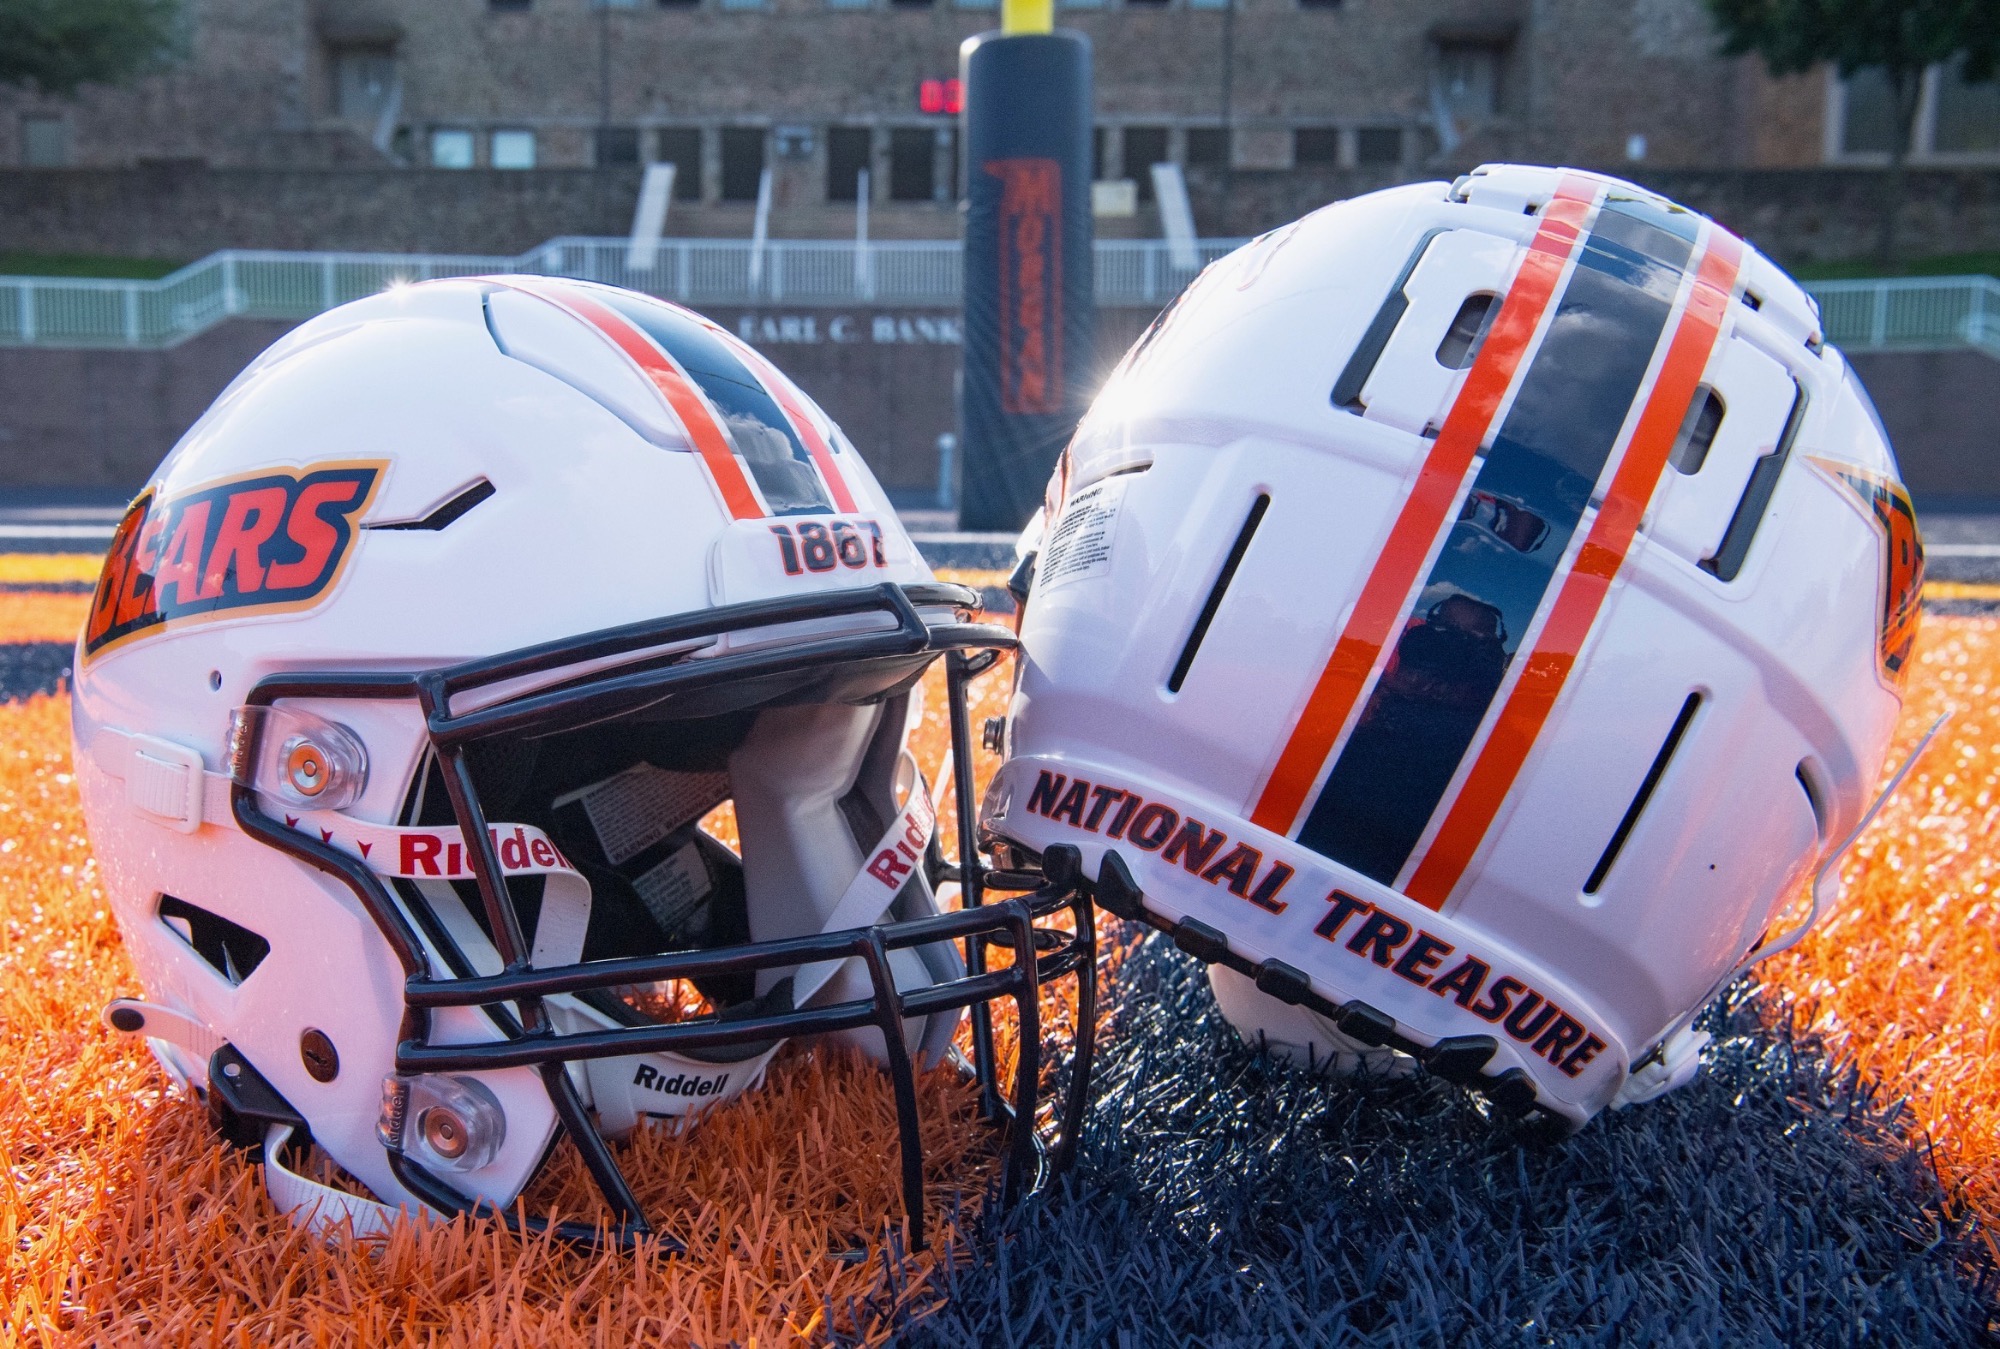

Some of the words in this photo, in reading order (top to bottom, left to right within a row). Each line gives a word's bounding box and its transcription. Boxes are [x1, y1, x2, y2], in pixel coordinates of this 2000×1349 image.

[86, 474, 370, 652] BEARS
[768, 519, 888, 577] 1867
[1026, 769, 1295, 915] NATIONAL
[1313, 888, 1608, 1079] TREASURE
[633, 1063, 730, 1097] Riddell
